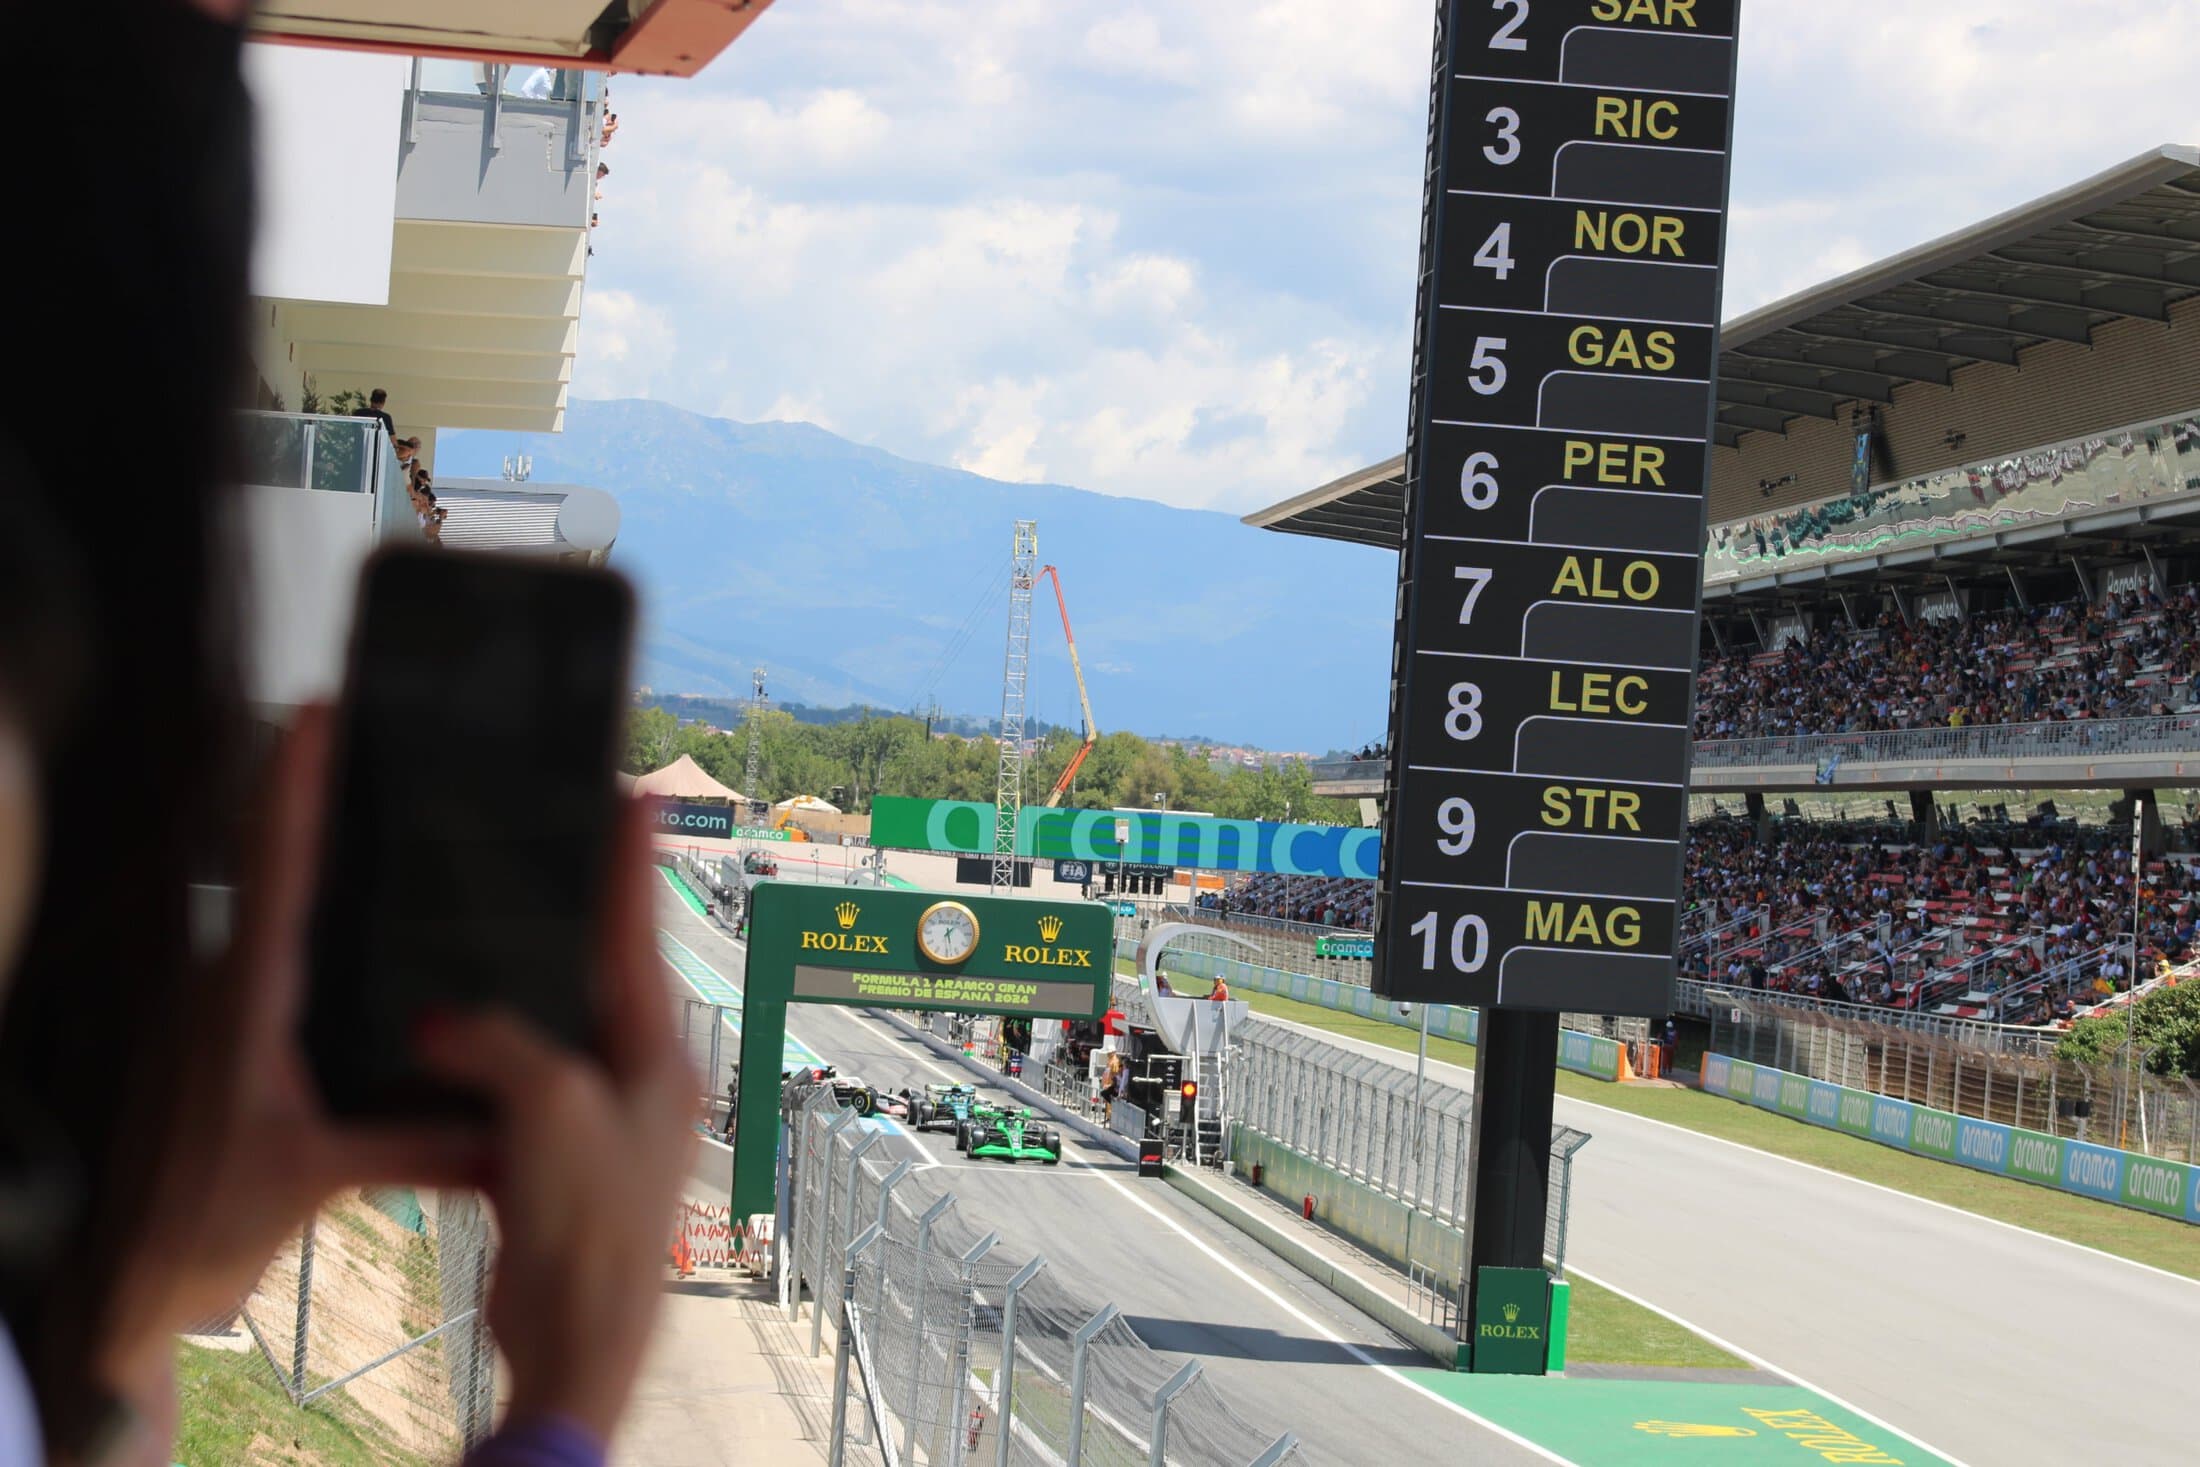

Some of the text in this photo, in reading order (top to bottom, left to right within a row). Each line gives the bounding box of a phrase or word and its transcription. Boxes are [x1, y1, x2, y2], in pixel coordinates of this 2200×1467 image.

[1488, 0, 1697, 51] 2 SAR
[1483, 97, 1680, 165] 3 RIC
[1473, 210, 1685, 281] 4 NOR
[1467, 326, 1676, 395] 5 GAS
[1461, 441, 1666, 510] 6 PER
[1454, 556, 1660, 625] 7 ALO
[1444, 670, 1649, 741] 8 LEC
[926, 799, 1380, 880] aramco
[1436, 786, 1642, 856] 9 STR
[1061, 865, 1084, 876] FIA
[801, 931, 889, 954] ROLEX
[1004, 945, 1092, 967] ROLEX
[1322, 943, 1372, 953] aramco
[1410, 900, 1642, 974] 10 MAG
[852, 972, 1037, 995] FORMULA 1 ARAMCO GRAN
[858, 983, 911, 997] PREMIO
[914, 988, 932, 998] DE
[994, 993, 1030, 1004] 2024
[1874, 1103, 1907, 1139] aramco
[1915, 1114, 1951, 1150] aramco
[1961, 1125, 2003, 1164] aramco
[2013, 1136, 2057, 1176] aramco
[2068, 1149, 2117, 1191] aramco
[2129, 1163, 2180, 1206] aramco
[1480, 1323, 1540, 1339] ROLEX
[1741, 1407, 1905, 1465] ROLEX
